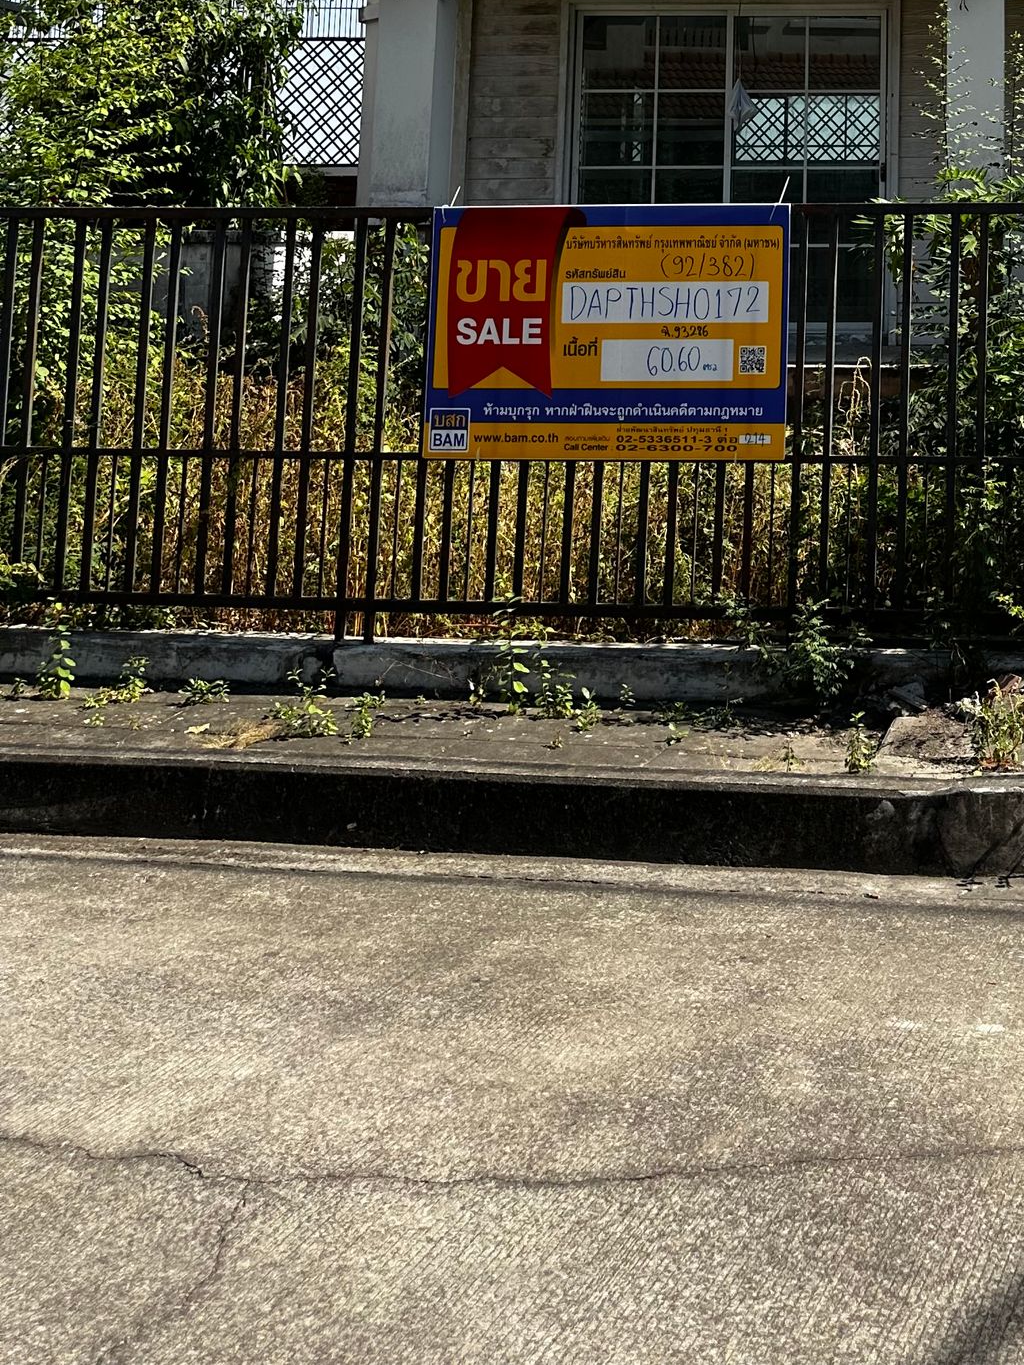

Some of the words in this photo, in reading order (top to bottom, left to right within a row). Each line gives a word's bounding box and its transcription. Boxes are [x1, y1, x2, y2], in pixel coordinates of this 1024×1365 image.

[566, 234, 652, 250] บริษัทบริหารสินทรัพย์
[654, 235, 717, 253] กรุงเทพพาณิชย์
[719, 236, 742, 249] จำกัด
[744, 237, 780, 250] (มหาชน)
[565, 267, 626, 279] รหัสทรัพย์สิน
[660, 253, 755, 279] (92/382)
[456, 258, 547, 302] ขาย
[456, 318, 543, 345] SALE
[563, 337, 598, 357] เนื้อที่
[647, 346, 701, 376] 60.60
[483, 403, 540, 420] ห้ามบุกรุก
[545, 403, 763, 420] หากฝ่าฝืนจะถูกดำเนินคดีตามกฎหมาย
[434, 414, 466, 427] บสก
[433, 433, 465, 447] BAM
[474, 433, 559, 444] www.bam.co.th
[616, 435, 712, 444] 02-5336511-3
[717, 433, 739, 444] ต่อ
[564, 443, 580, 451] Call
[581, 443, 609, 452] Center
[616, 444, 738, 452] 02-6300-700
